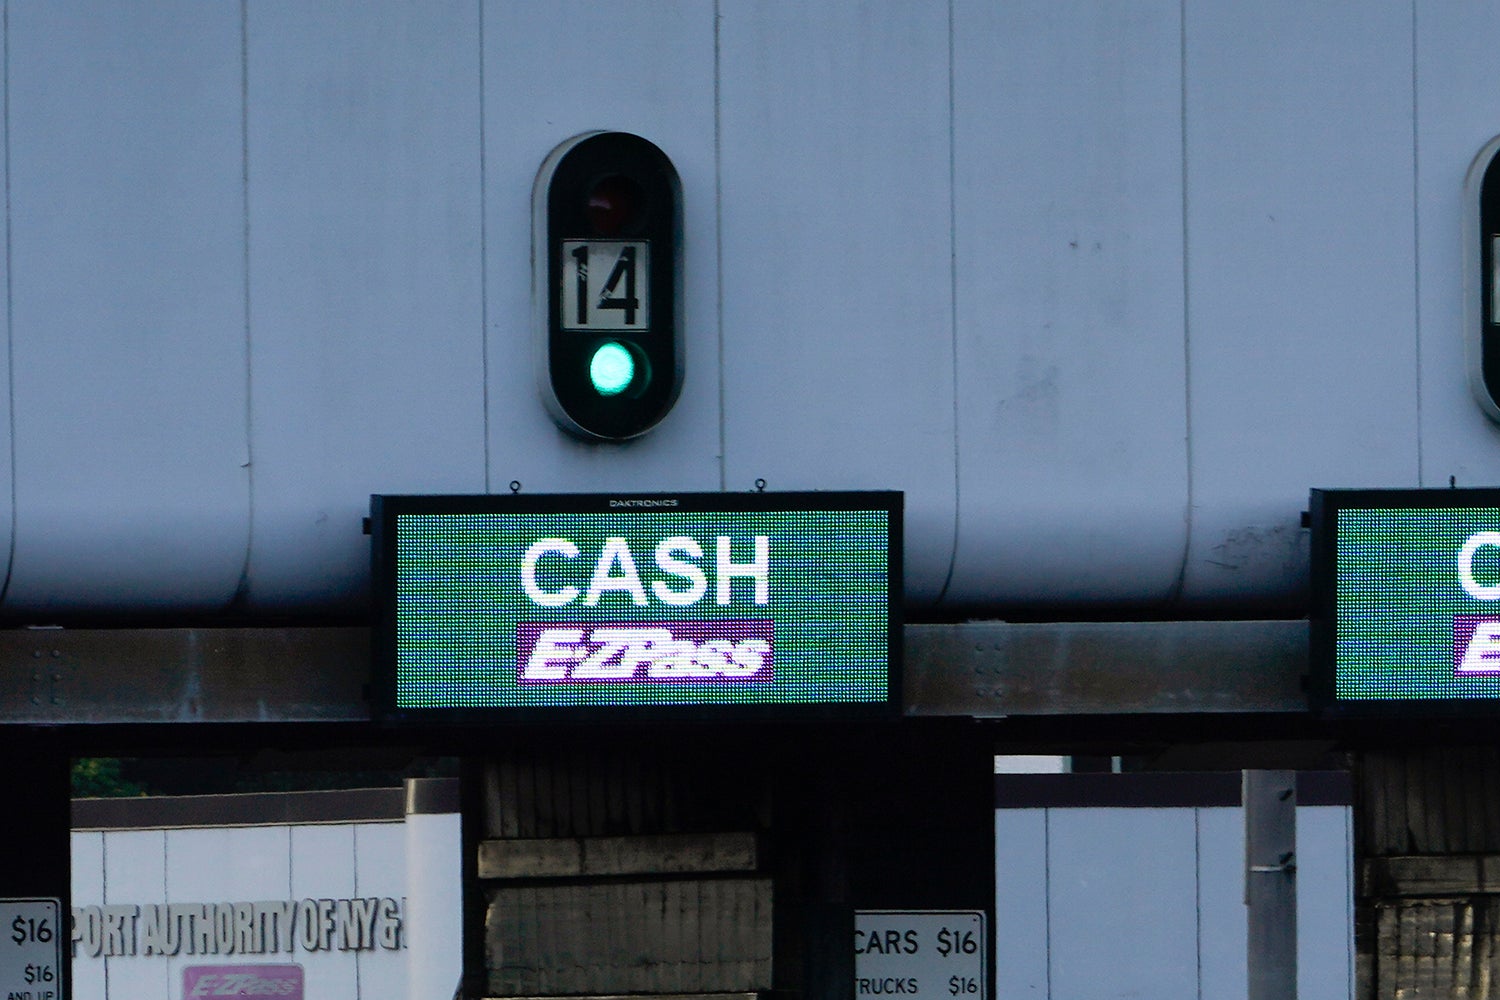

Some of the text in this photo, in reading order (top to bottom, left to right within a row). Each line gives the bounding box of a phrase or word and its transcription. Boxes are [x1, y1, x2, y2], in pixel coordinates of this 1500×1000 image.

[571, 245, 639, 324] 14
[609, 499, 679, 508] DAKTRONICS
[520, 535, 770, 608] CASH
[12, 915, 52, 946] $16
[71, 904, 140, 957] PORT
[142, 900, 297, 956] AUTHORITY
[300, 897, 336, 951] OF
[338, 897, 378, 951] NY
[936, 927, 977, 957] $16
[24, 963, 54, 985] $16
[948, 975, 978, 996] $16
